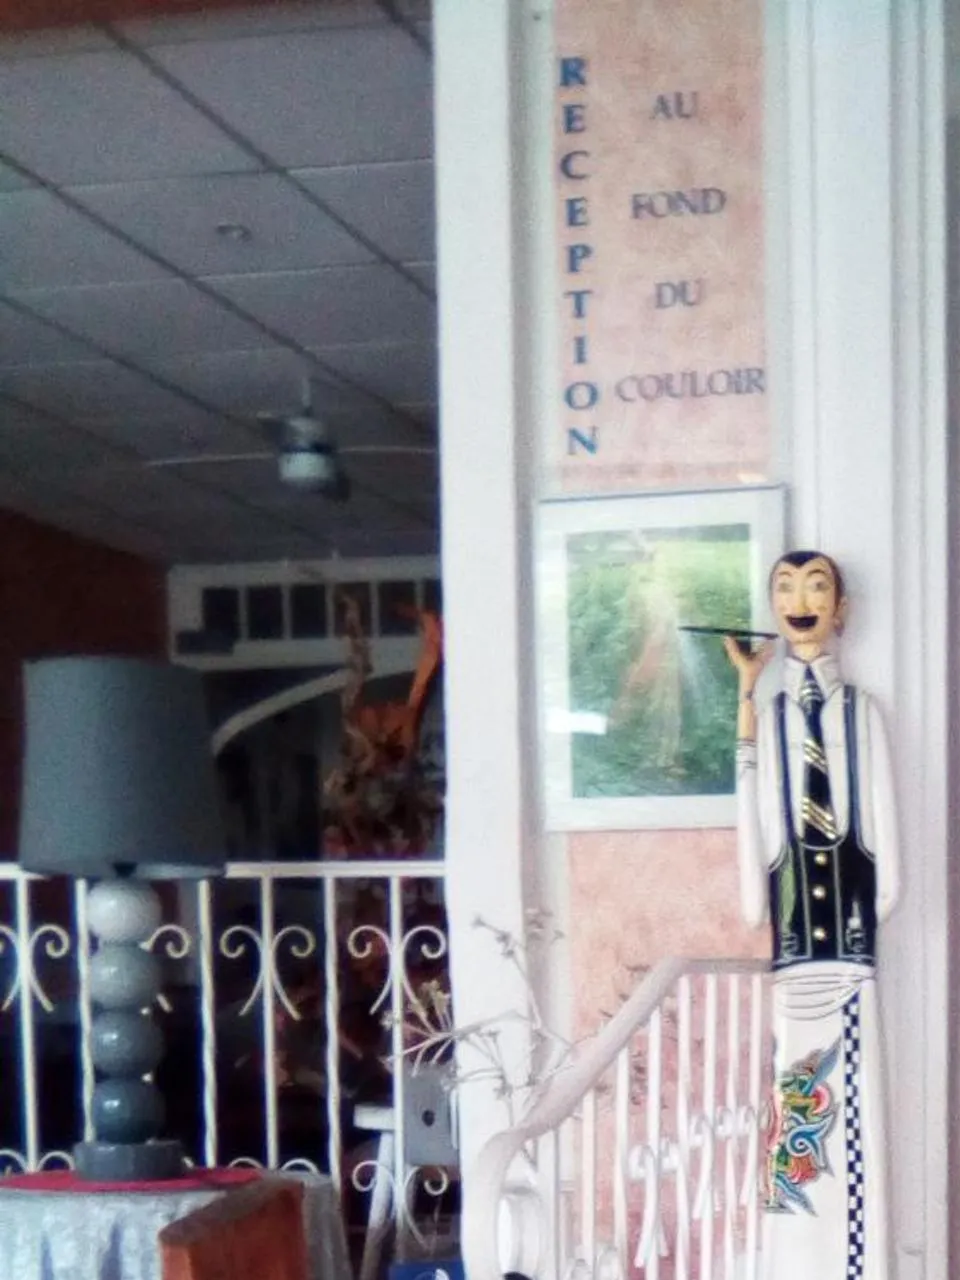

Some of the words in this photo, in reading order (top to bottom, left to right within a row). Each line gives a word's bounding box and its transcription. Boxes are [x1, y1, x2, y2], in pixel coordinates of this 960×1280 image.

[651, 92, 698, 122] AU
[630, 188, 728, 220] FOND
[559, 57, 598, 455] RECEPTION
[654, 280, 704, 310] DU
[614, 367, 768, 402] COULOIR
